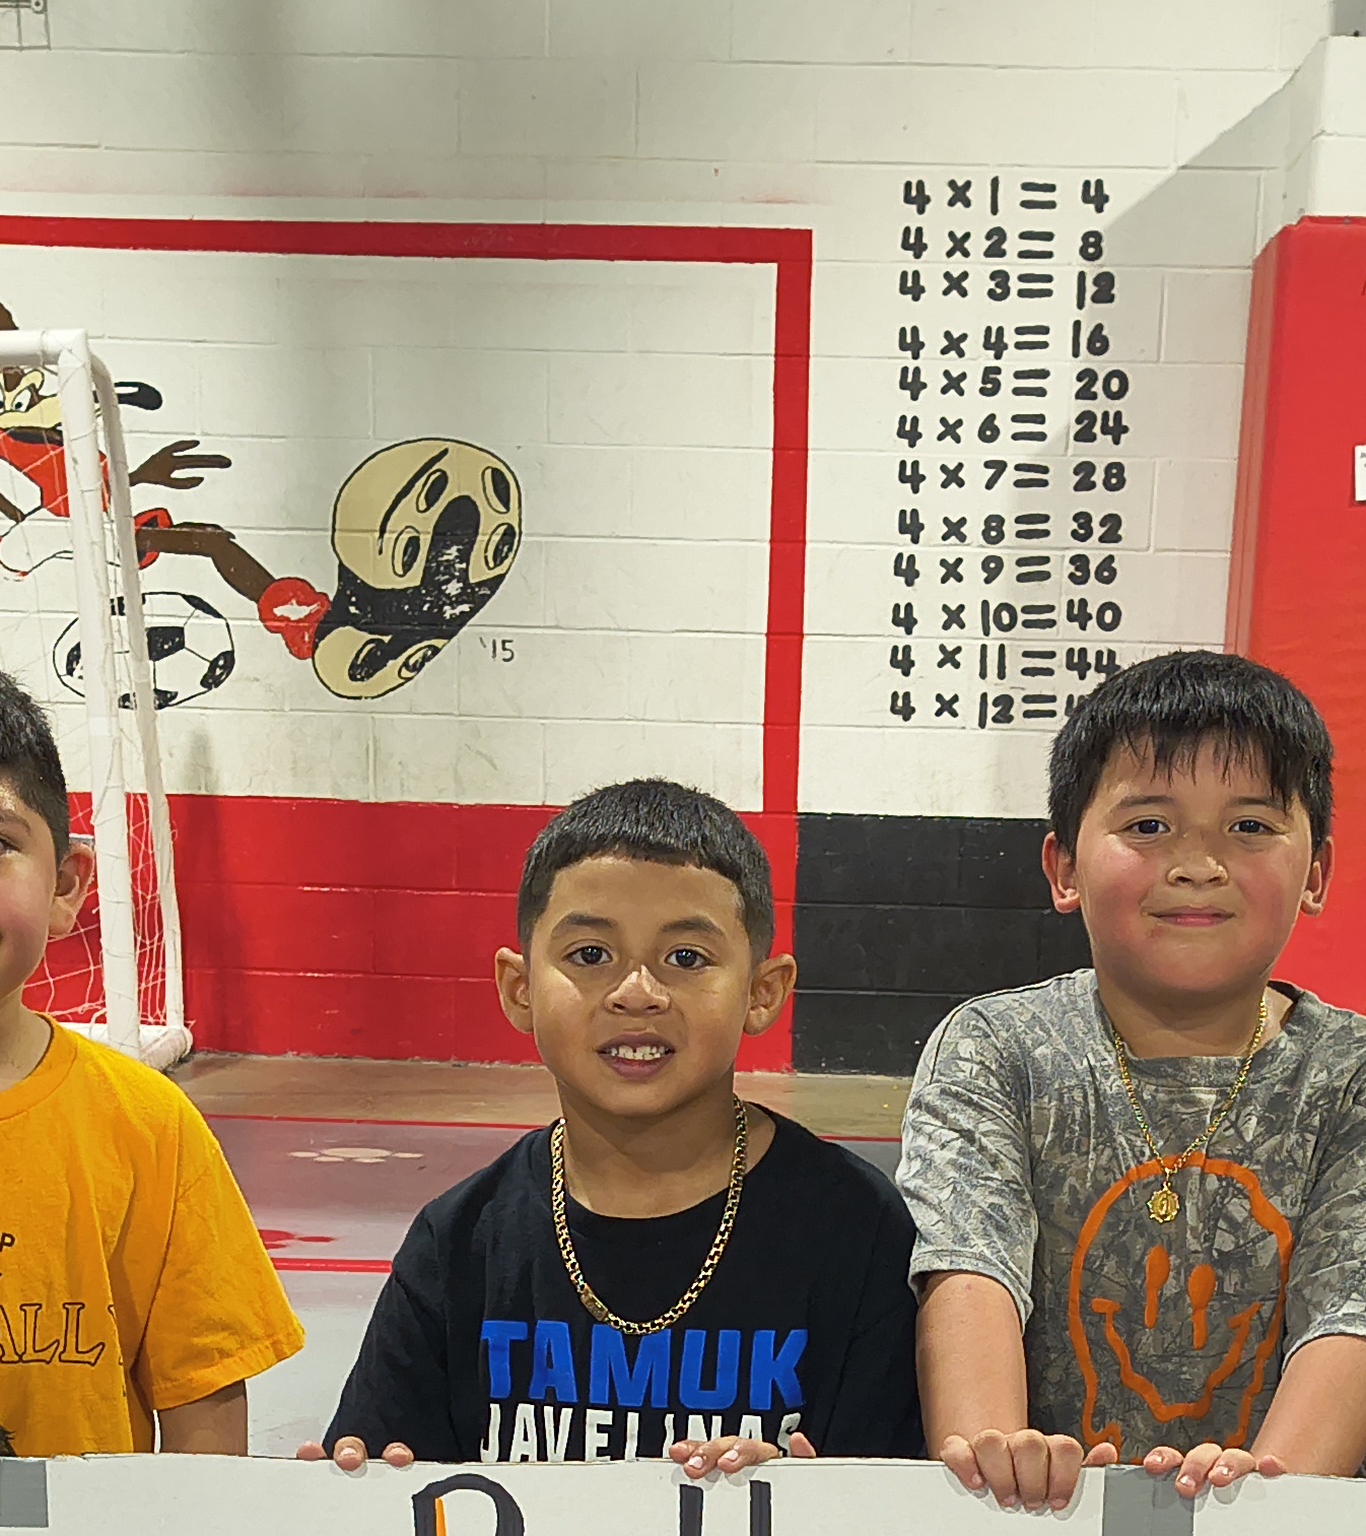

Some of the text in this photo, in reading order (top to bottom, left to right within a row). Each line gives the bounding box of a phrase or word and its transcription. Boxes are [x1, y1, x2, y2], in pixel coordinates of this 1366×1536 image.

[903, 179, 931, 216] 4
[990, 175, 1000, 216] 1
[1081, 178, 1110, 214] 4
[900, 225, 928, 260] 4
[983, 226, 1007, 259] 2
[1078, 230, 1103, 262] 8
[899, 269, 1115, 311] 4 3 12
[898, 319, 1110, 361] 4 4 16
[899, 365, 1129, 402] 4 5 20
[896, 409, 1130, 449] 4 6 24
[898, 459, 1127, 495] 4 7 28
[898, 508, 1123, 546] 4 8 32
[893, 552, 1118, 588] 4 9 36
[891, 597, 1123, 637] 4 10 40
[889, 644, 916, 678] 4
[978, 643, 1007, 681] 11
[889, 690, 1015, 730] 4 12
[480, 1319, 809, 1411] TAMUK
